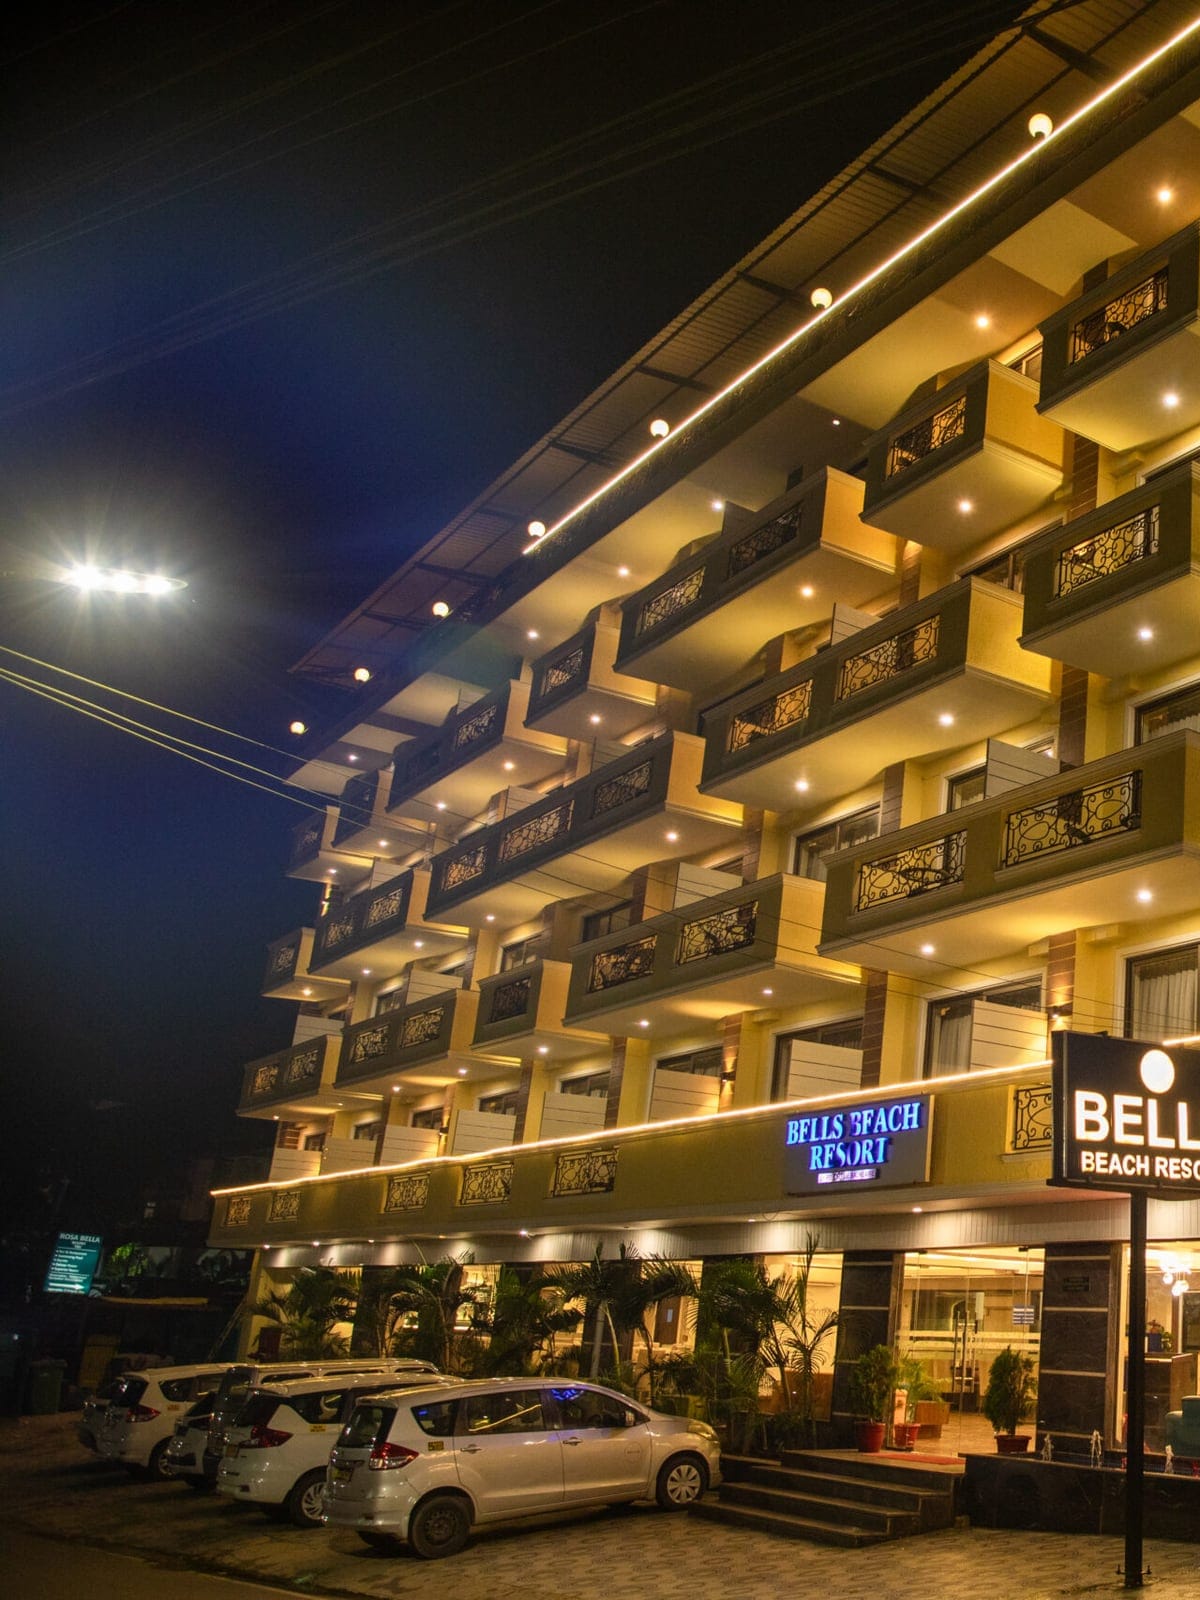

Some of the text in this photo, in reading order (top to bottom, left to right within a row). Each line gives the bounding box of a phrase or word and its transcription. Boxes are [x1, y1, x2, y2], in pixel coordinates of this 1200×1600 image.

[786, 1102, 921, 1145] BELLS BEACH
[809, 1137, 889, 1170] RESORT
[1081, 1151, 1150, 1176] BEACH
[59, 1233, 79, 1241] ROSA
[80, 1235, 100, 1243] BELLA
